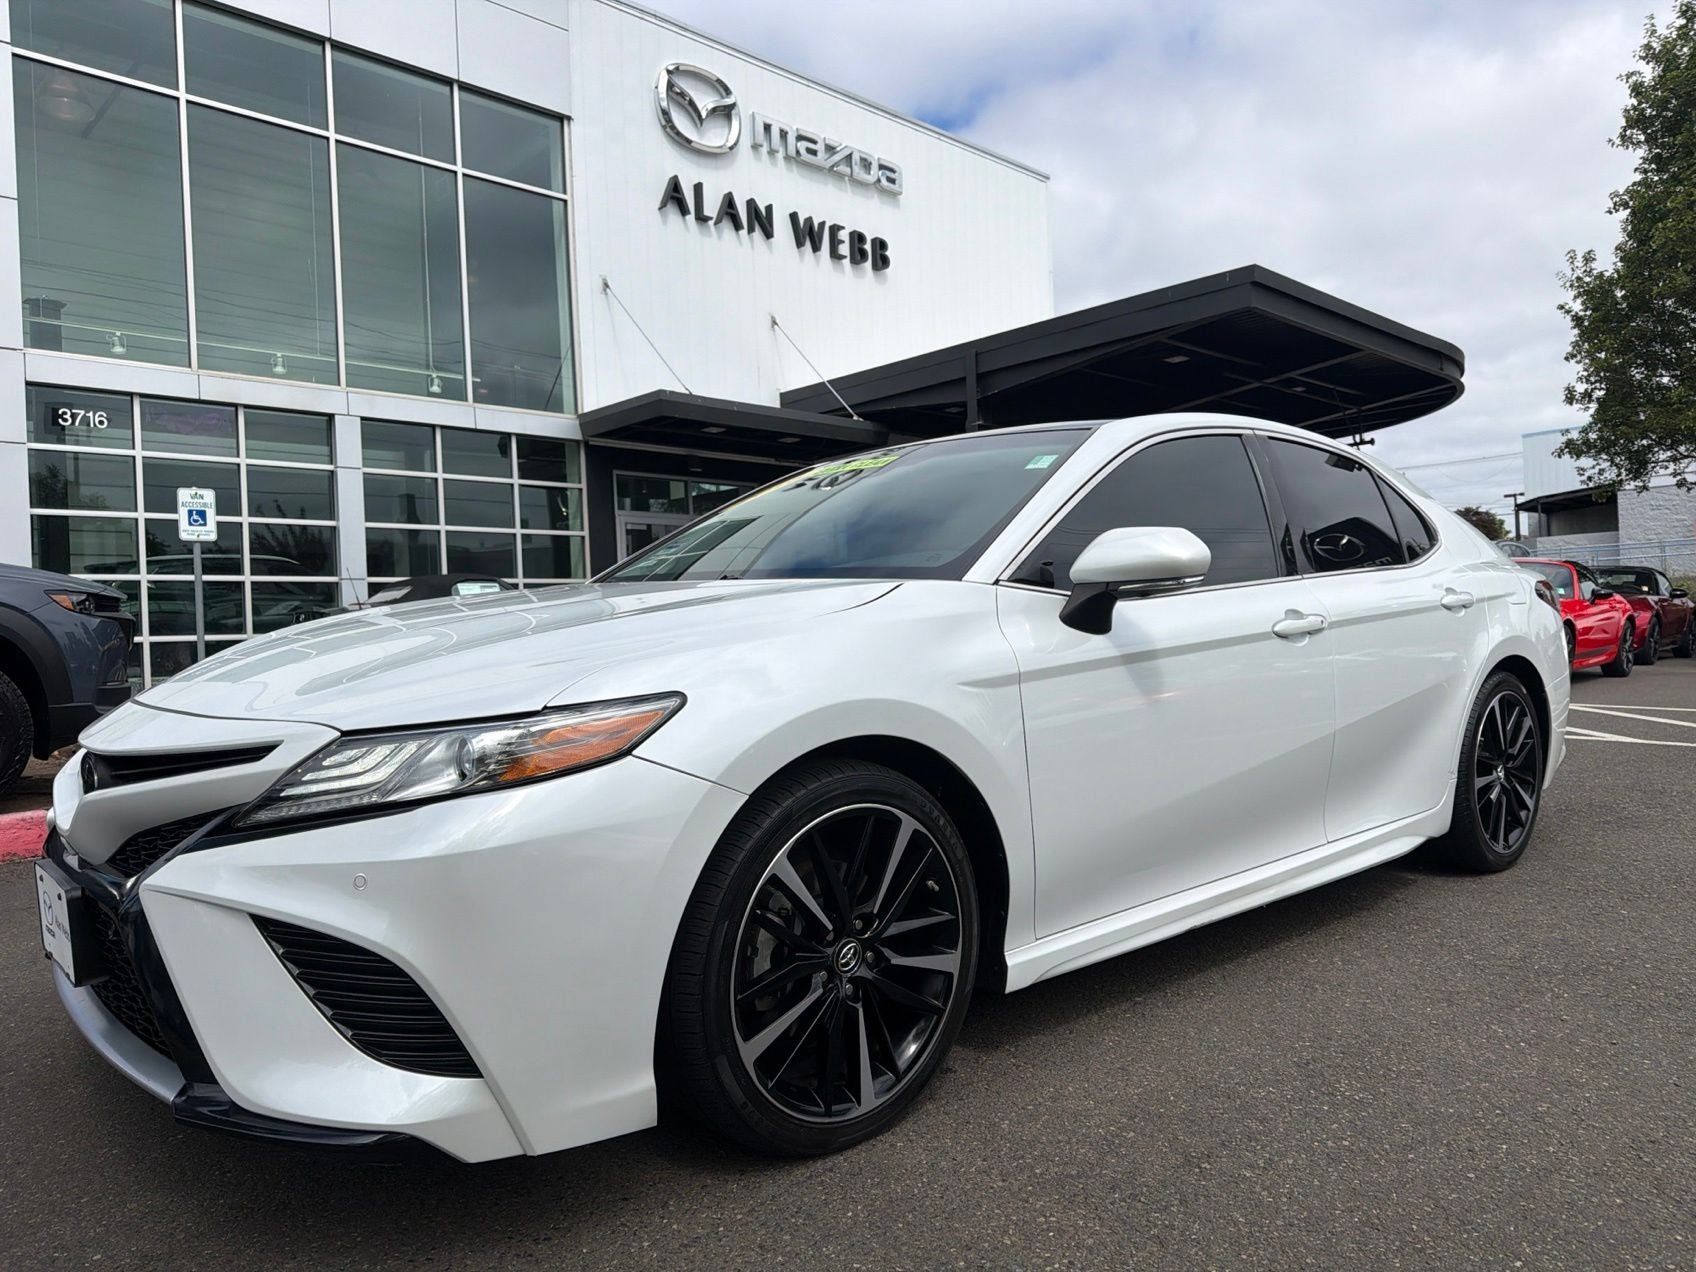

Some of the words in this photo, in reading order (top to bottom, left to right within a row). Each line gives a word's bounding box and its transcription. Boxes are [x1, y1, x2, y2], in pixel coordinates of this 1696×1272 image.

[750, 111, 903, 196] mazda
[658, 174, 775, 241] ALAN
[789, 210, 891, 272] WEBB
[58, 408, 108, 428] 3716
[181, 501, 213, 509] ACCESSIBLE
